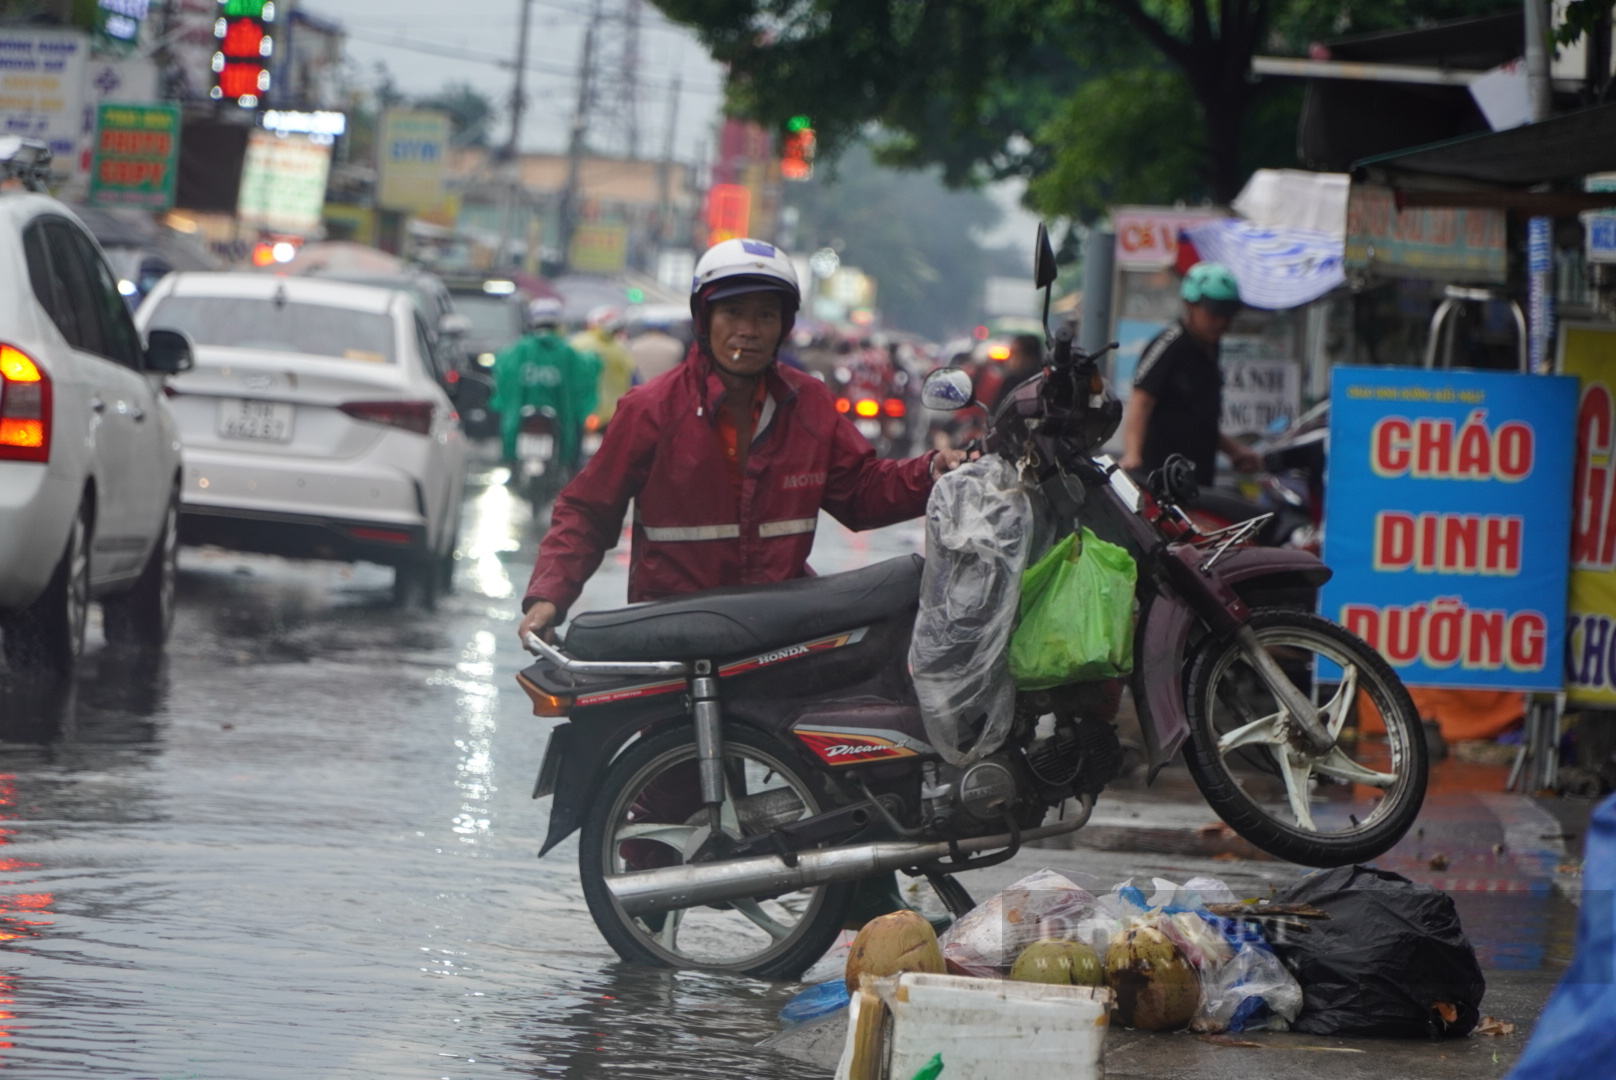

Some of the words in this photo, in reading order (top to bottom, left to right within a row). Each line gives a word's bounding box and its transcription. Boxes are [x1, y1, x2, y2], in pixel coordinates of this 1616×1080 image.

[1371, 408, 1534, 482] CHÁO
[1373, 511, 1523, 576] DINH
[758, 645, 809, 665] HONDA
[1341, 595, 1547, 671] DƯỠNG
[824, 744, 888, 757] Dream
